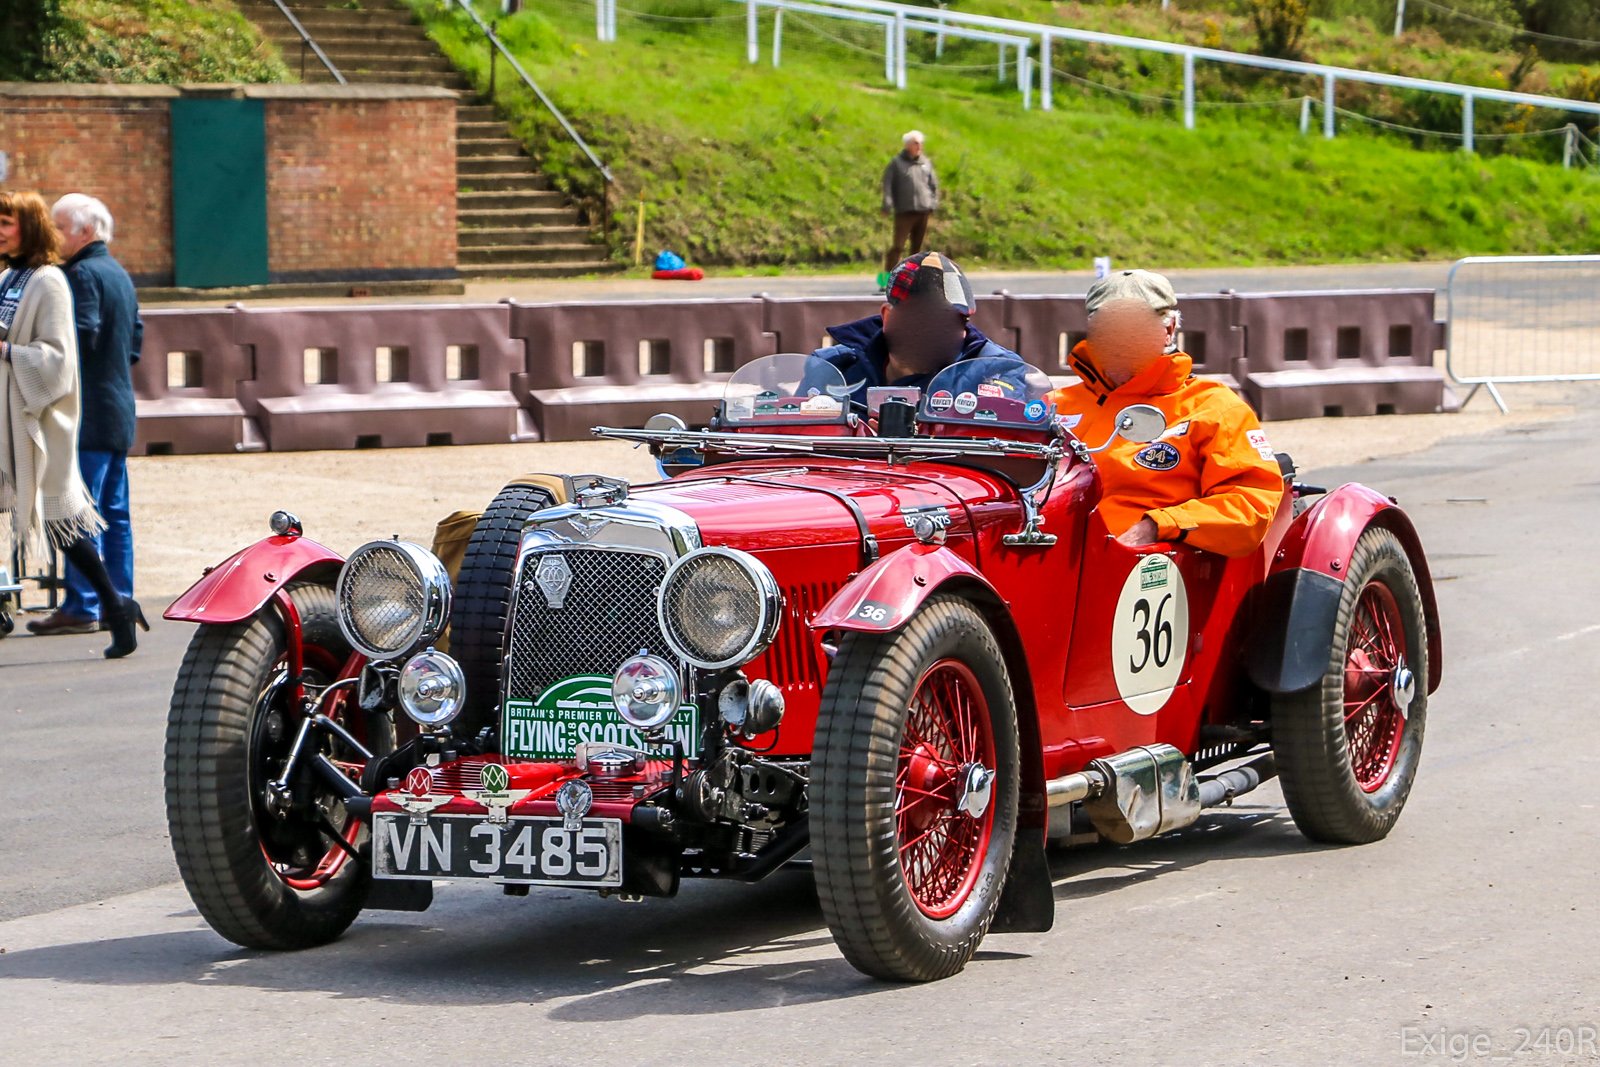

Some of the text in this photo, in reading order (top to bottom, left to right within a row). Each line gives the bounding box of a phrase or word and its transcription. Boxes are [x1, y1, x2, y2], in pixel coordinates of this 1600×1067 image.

[1145, 449, 1166, 463] 34
[858, 604, 887, 621] 36
[1129, 592, 1173, 674] 36
[510, 707, 555, 719] BRITAIN'S
[558, 709, 603, 721] PREMIER
[510, 719, 567, 753] FLYING
[567, 722, 577, 753] 2018
[388, 822, 608, 877] VN 3485
